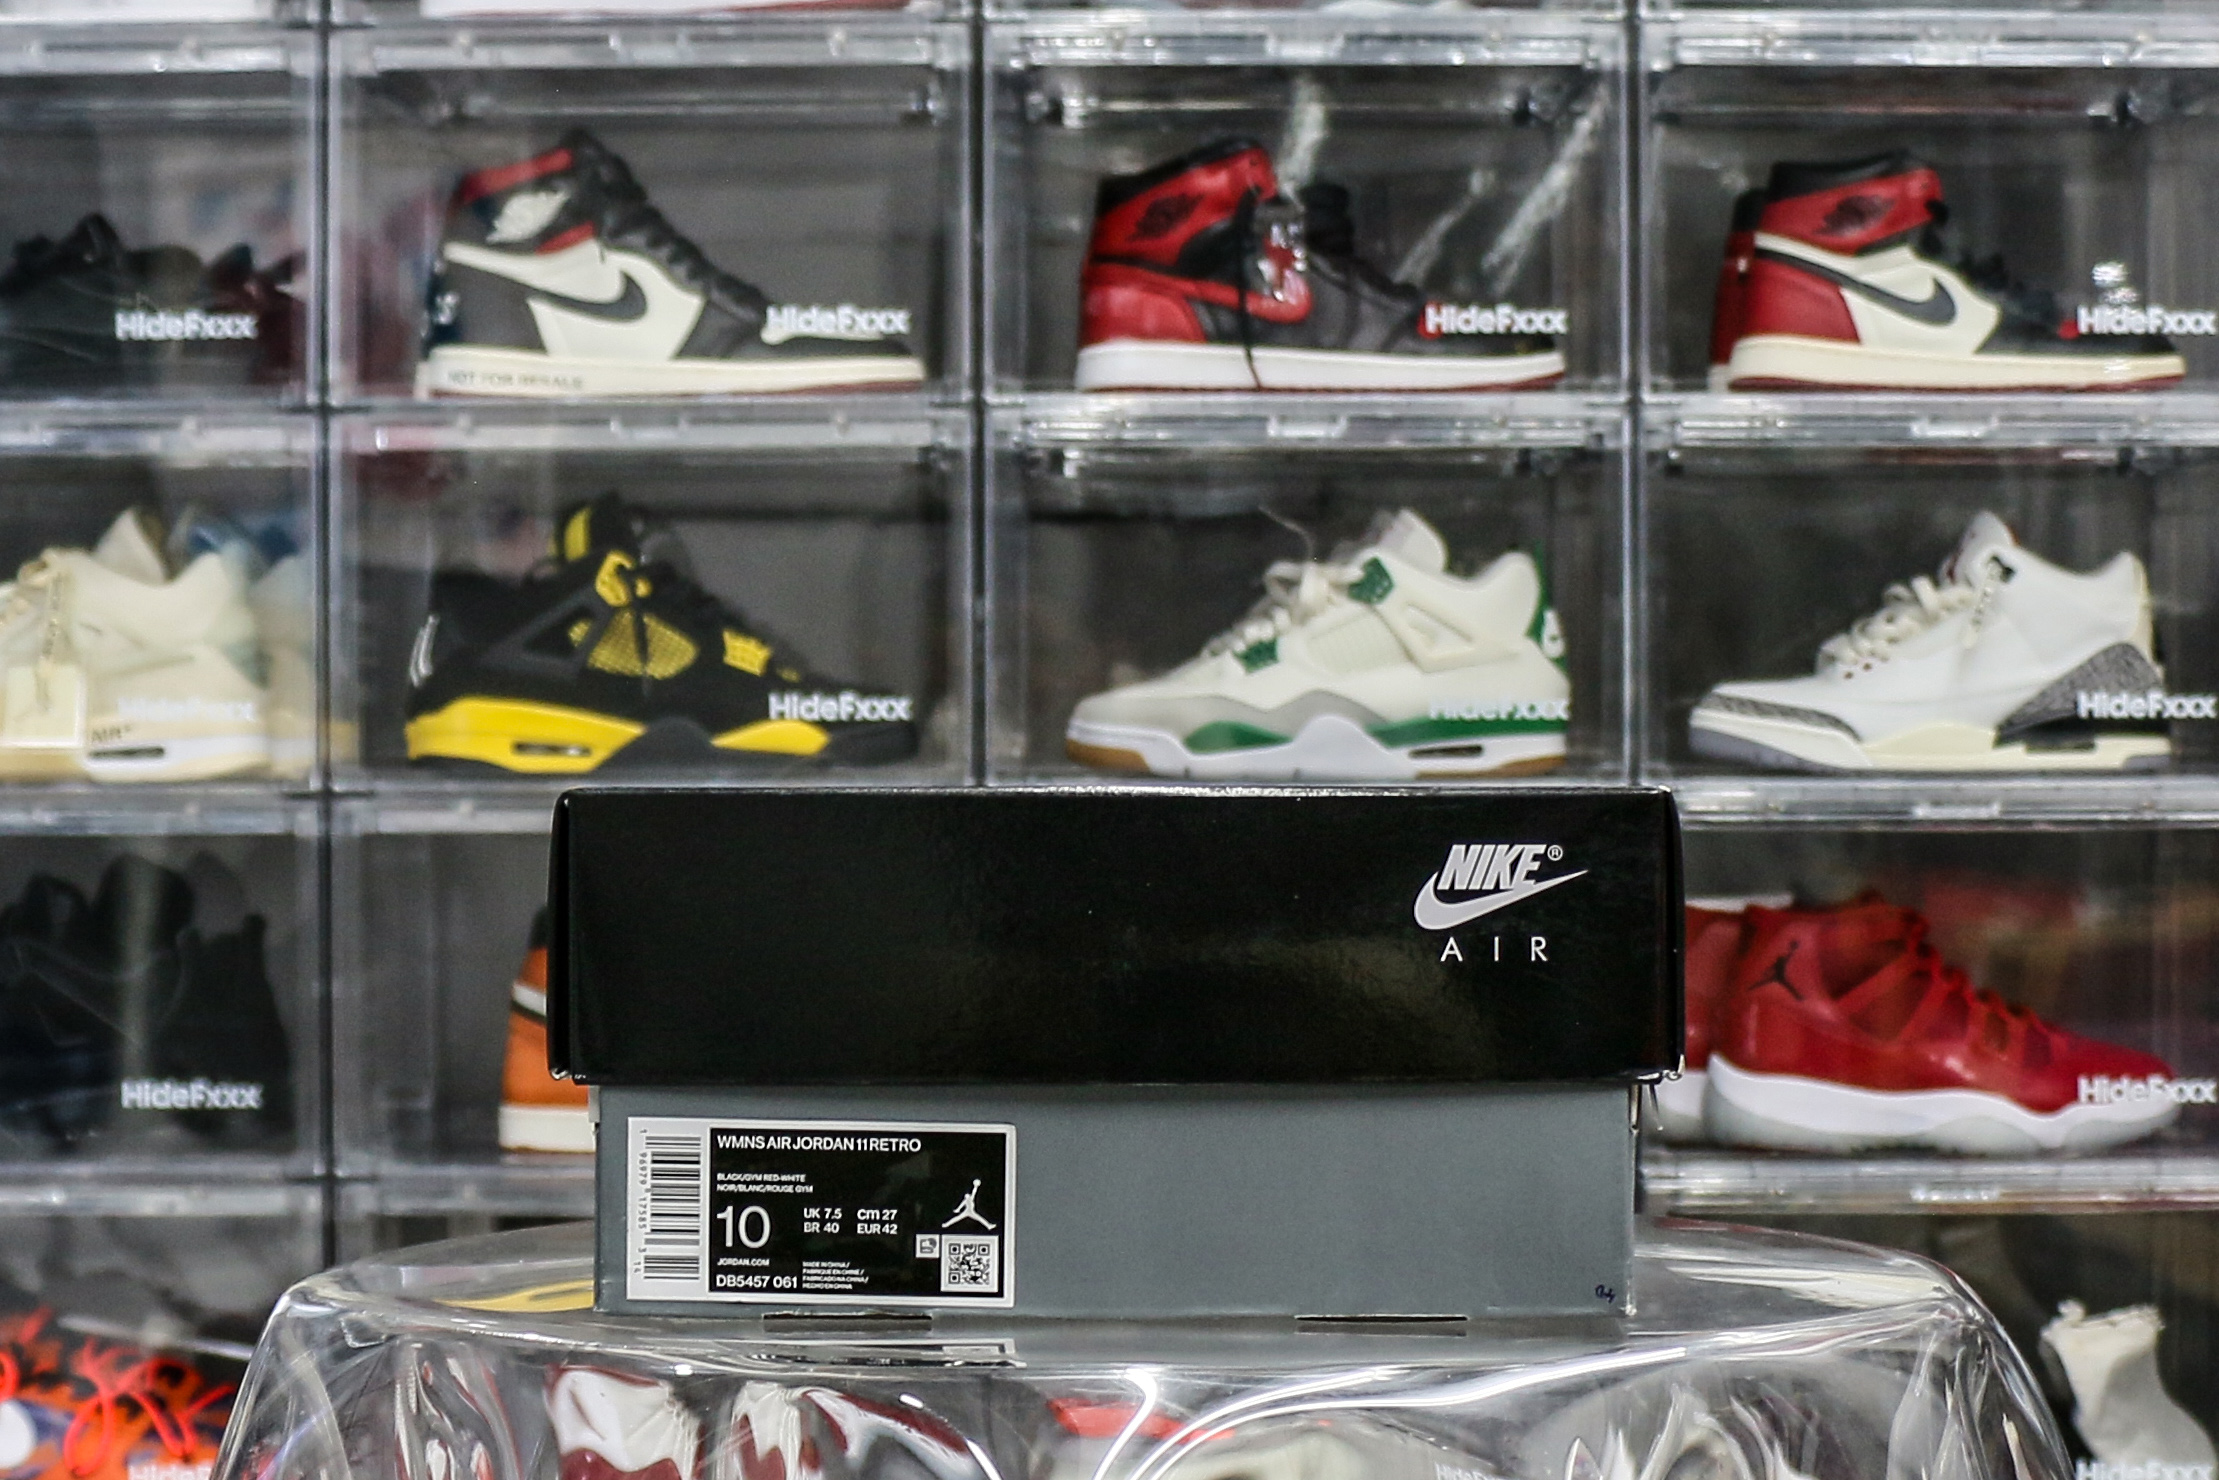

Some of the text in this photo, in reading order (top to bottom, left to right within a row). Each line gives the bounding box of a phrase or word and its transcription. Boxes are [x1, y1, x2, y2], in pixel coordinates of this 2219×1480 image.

[115, 309, 259, 341] HideFxxx
[766, 302, 911, 334] HideFxxx
[1425, 302, 1569, 334] HideFxxx
[2077, 304, 2217, 335] HideFxxx
[768, 690, 912, 721] HideFxxx
[2076, 690, 2217, 719] HideFxxx
[1440, 936, 1548, 962] AIR
[121, 1078, 264, 1109] HideFxxx
[716, 1135, 922, 1152] WMNS AIR JORDAN 11 RETRO
[717, 1206, 771, 1249] 10
[803, 1208, 842, 1220] UK 7.5
[803, 1222, 840, 1233] BR 40
[881, 1209, 898, 1220] 27
[856, 1223, 898, 1235] EUR 42
[717, 1258, 770, 1266] JORDAN.COM
[716, 1274, 798, 1288] DB5457 061
